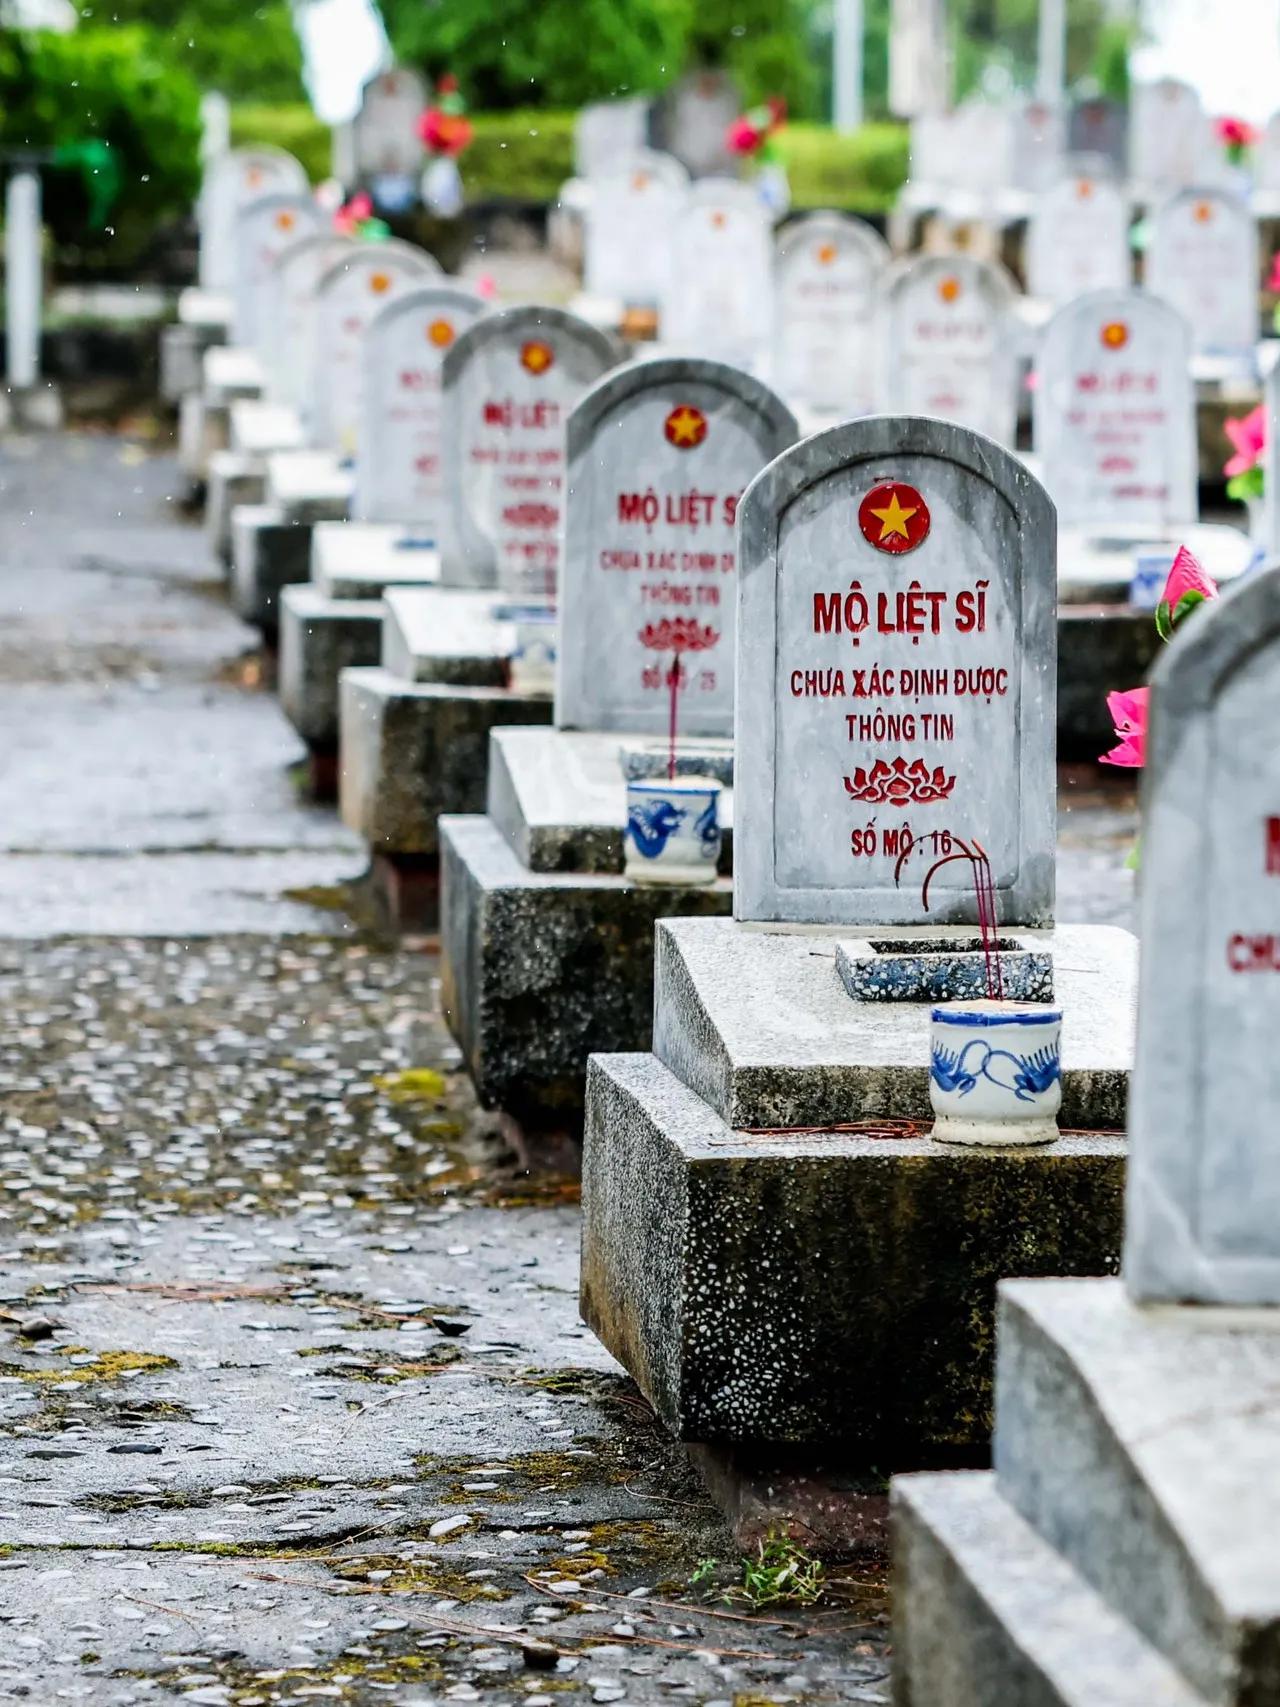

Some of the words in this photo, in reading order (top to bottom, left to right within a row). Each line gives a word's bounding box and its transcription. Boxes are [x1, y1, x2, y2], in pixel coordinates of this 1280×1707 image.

[618, 486, 660, 535] MỘ
[666, 487, 717, 534] LIỆT
[723, 494, 738, 526] S
[813, 579, 870, 647] MỘ
[877, 579, 948, 645] LIỆT
[954, 579, 990, 634] SĨ
[790, 667, 846, 697] CHƯA
[852, 662, 895, 699] XÁC
[899, 668, 949, 704] ĐỊNH
[953, 665, 1008, 704] ĐƯỢC
[845, 707, 916, 742] THÔNG
[920, 714, 954, 742] TIN
[851, 817, 877, 857] SỐ
[883, 822, 914, 865] MỘ
[930, 829, 952, 857] 16
